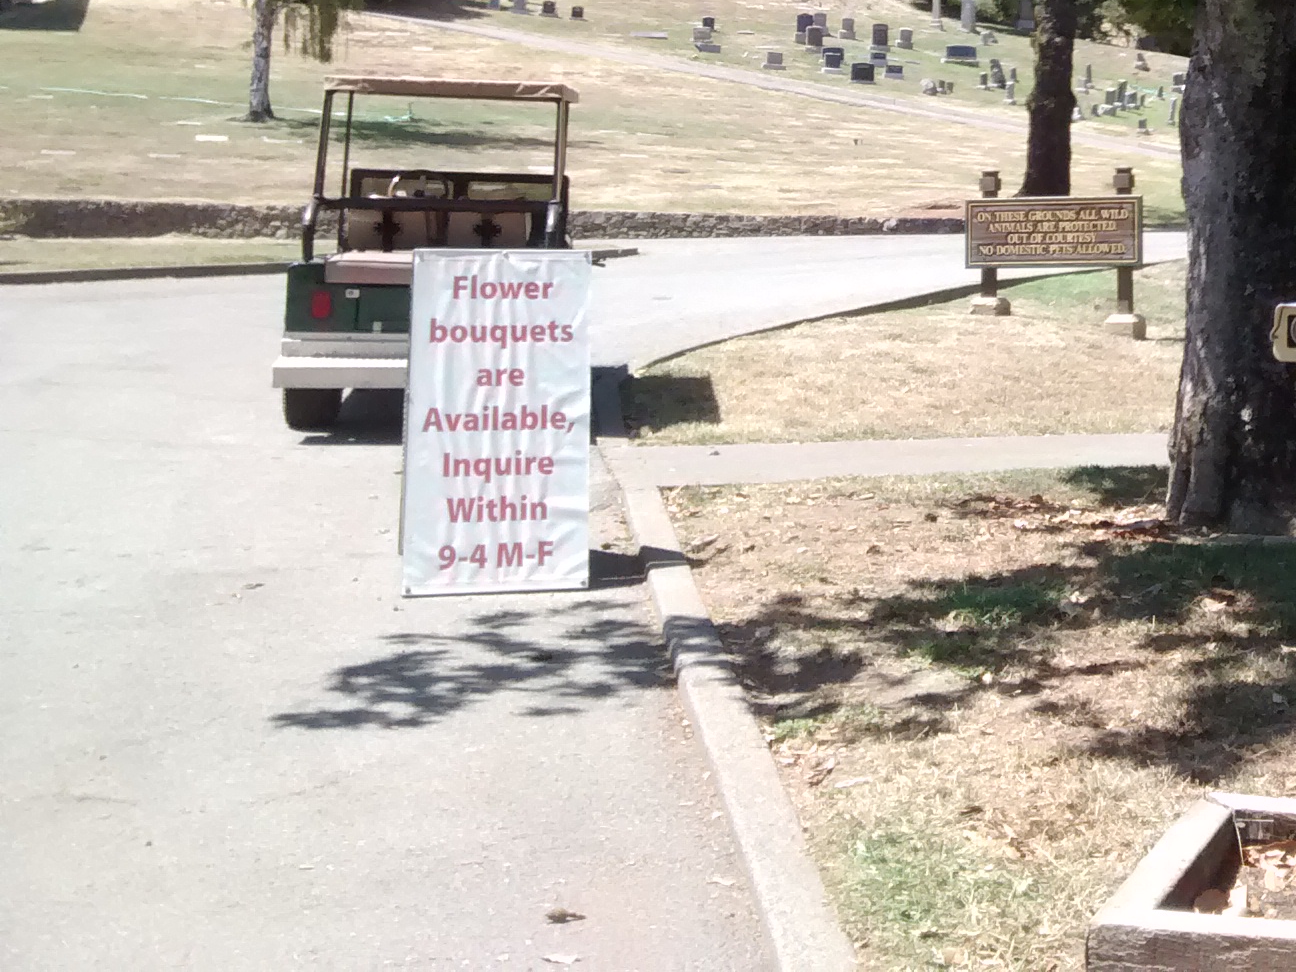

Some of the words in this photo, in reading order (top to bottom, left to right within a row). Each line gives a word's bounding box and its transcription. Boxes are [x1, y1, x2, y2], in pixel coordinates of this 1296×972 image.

[977, 211, 992, 222] ON
[994, 211, 1026, 221] THESE
[1028, 210, 1076, 221] GROUNDS
[1079, 209, 1098, 220] ALL
[1100, 209, 1129, 219] WILD
[988, 222, 1033, 233] ANIMALS
[1036, 222, 1056, 232] ARE
[979, 245, 994, 256] NO
[996, 244, 1047, 255] DOMESTIC
[1049, 244, 1073, 254] PETS
[1007, 234, 1028, 244] OUT
[1031, 234, 1044, 243] OF
[1046, 232, 1097, 243] COURTESY
[452, 275, 554, 300] Flower
[429, 318, 574, 349] bouquets
[476, 368, 525, 386] are
[422, 405, 575, 433] Available,
[442, 450, 555, 483] Inquire
[446, 495, 548, 523] Within
[438, 545, 488, 570] 9-4
[496, 541, 554, 568] M-F
